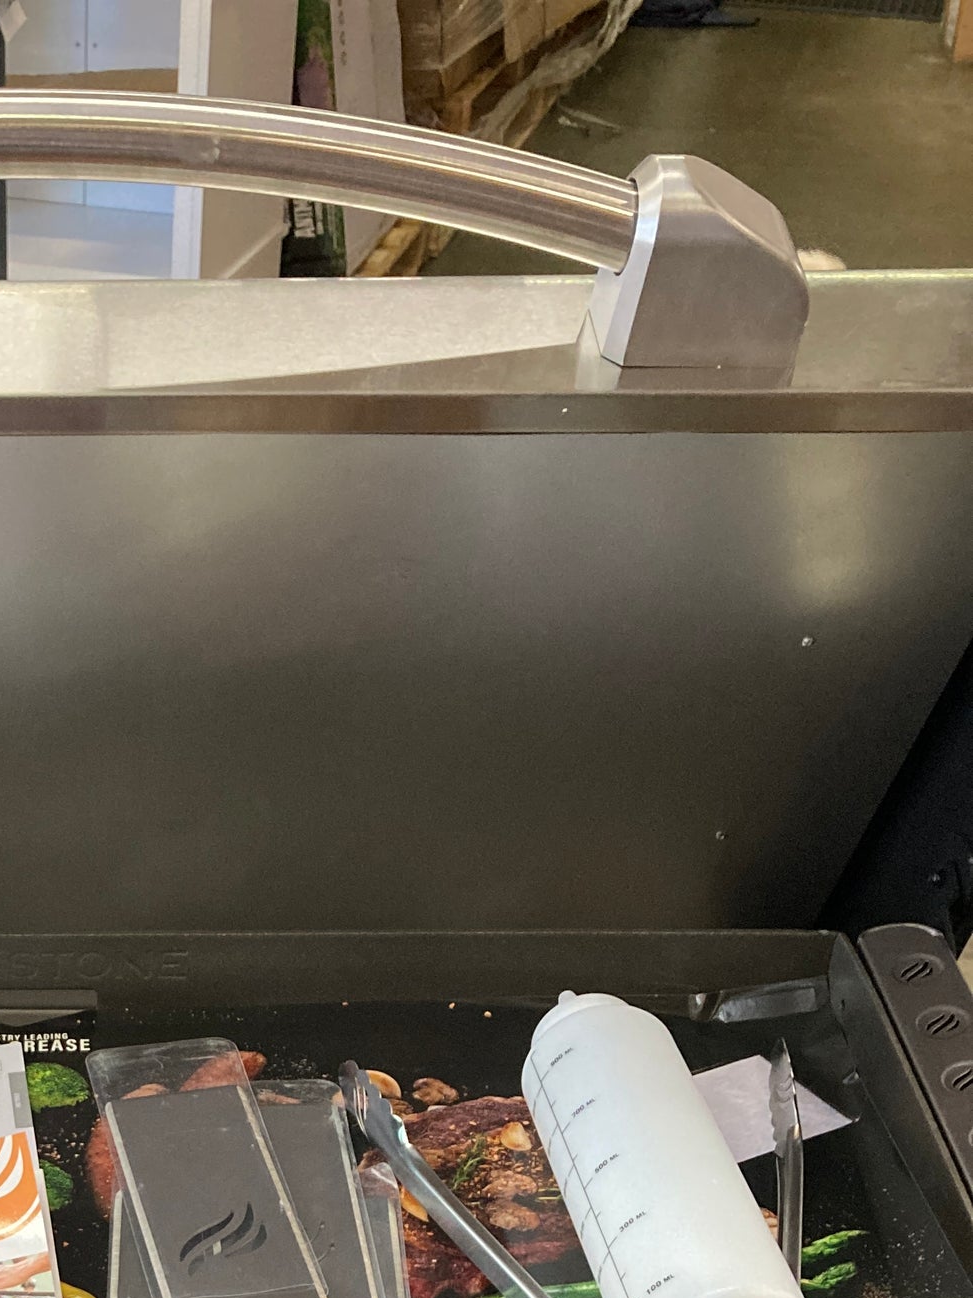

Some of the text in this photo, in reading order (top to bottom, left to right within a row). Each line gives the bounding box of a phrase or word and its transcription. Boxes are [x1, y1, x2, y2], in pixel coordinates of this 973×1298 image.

[24, 1032, 69, 1041] LEADING
[572, 1104, 585, 1118] 700
[594, 1152, 620, 1174] 500 ML
[619, 1210, 647, 1233] 300 ML
[646, 1273, 676, 1295] 100 ML
